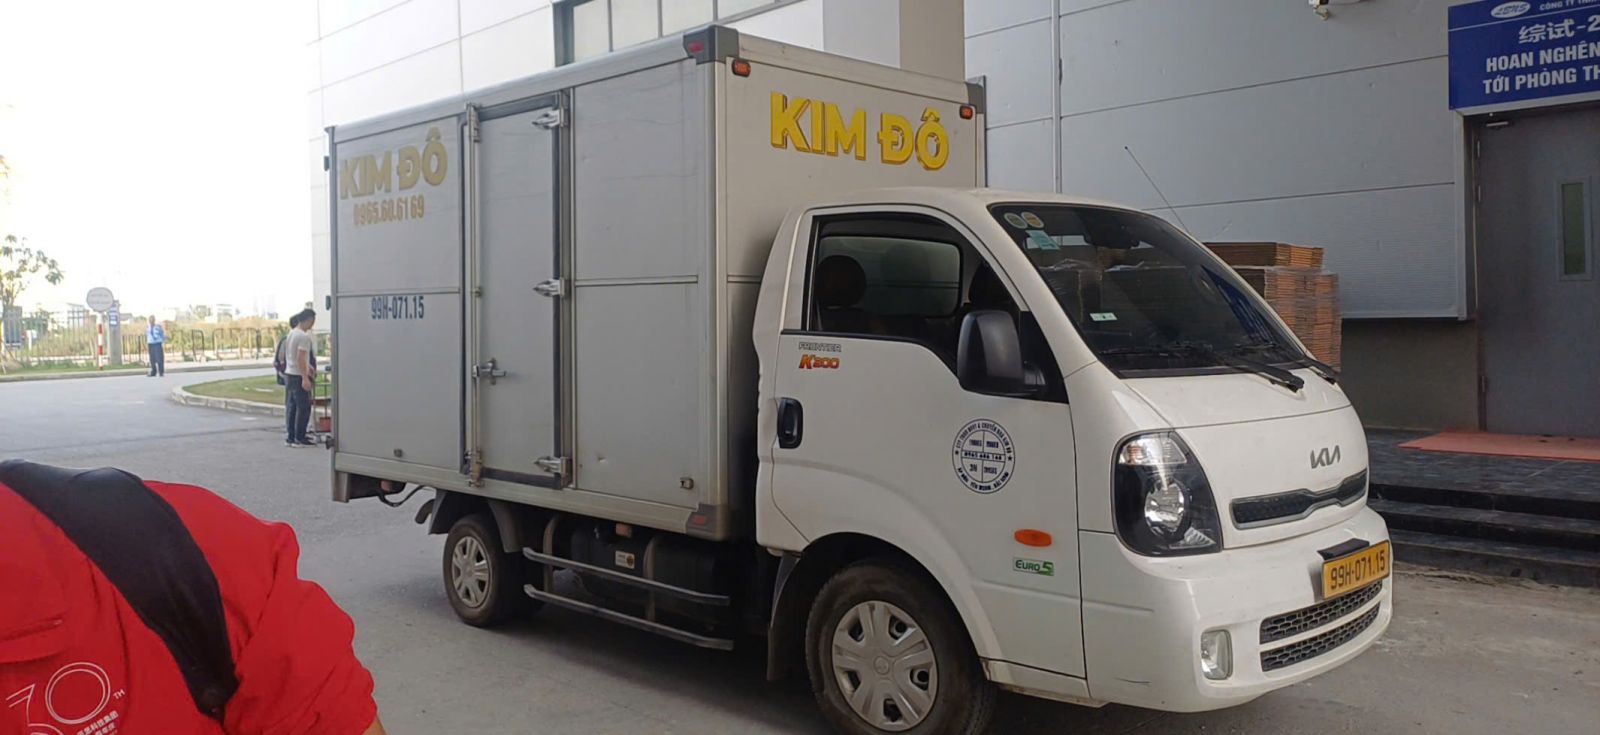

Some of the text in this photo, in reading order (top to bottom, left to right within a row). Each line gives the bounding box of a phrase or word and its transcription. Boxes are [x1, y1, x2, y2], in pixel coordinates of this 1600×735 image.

[1486, 53, 1534, 72] HOAN
[1483, 75, 1509, 94] TỚI
[1515, 68, 1577, 90] PHÒNG
[770, 91, 949, 170] KIM ĐÔ
[339, 127, 448, 200] KIM ĐÔ
[371, 295, 425, 320] 99H-071.15
[1310, 445, 1341, 469] KIA
[1330, 550, 1385, 590] 99H-071.15
